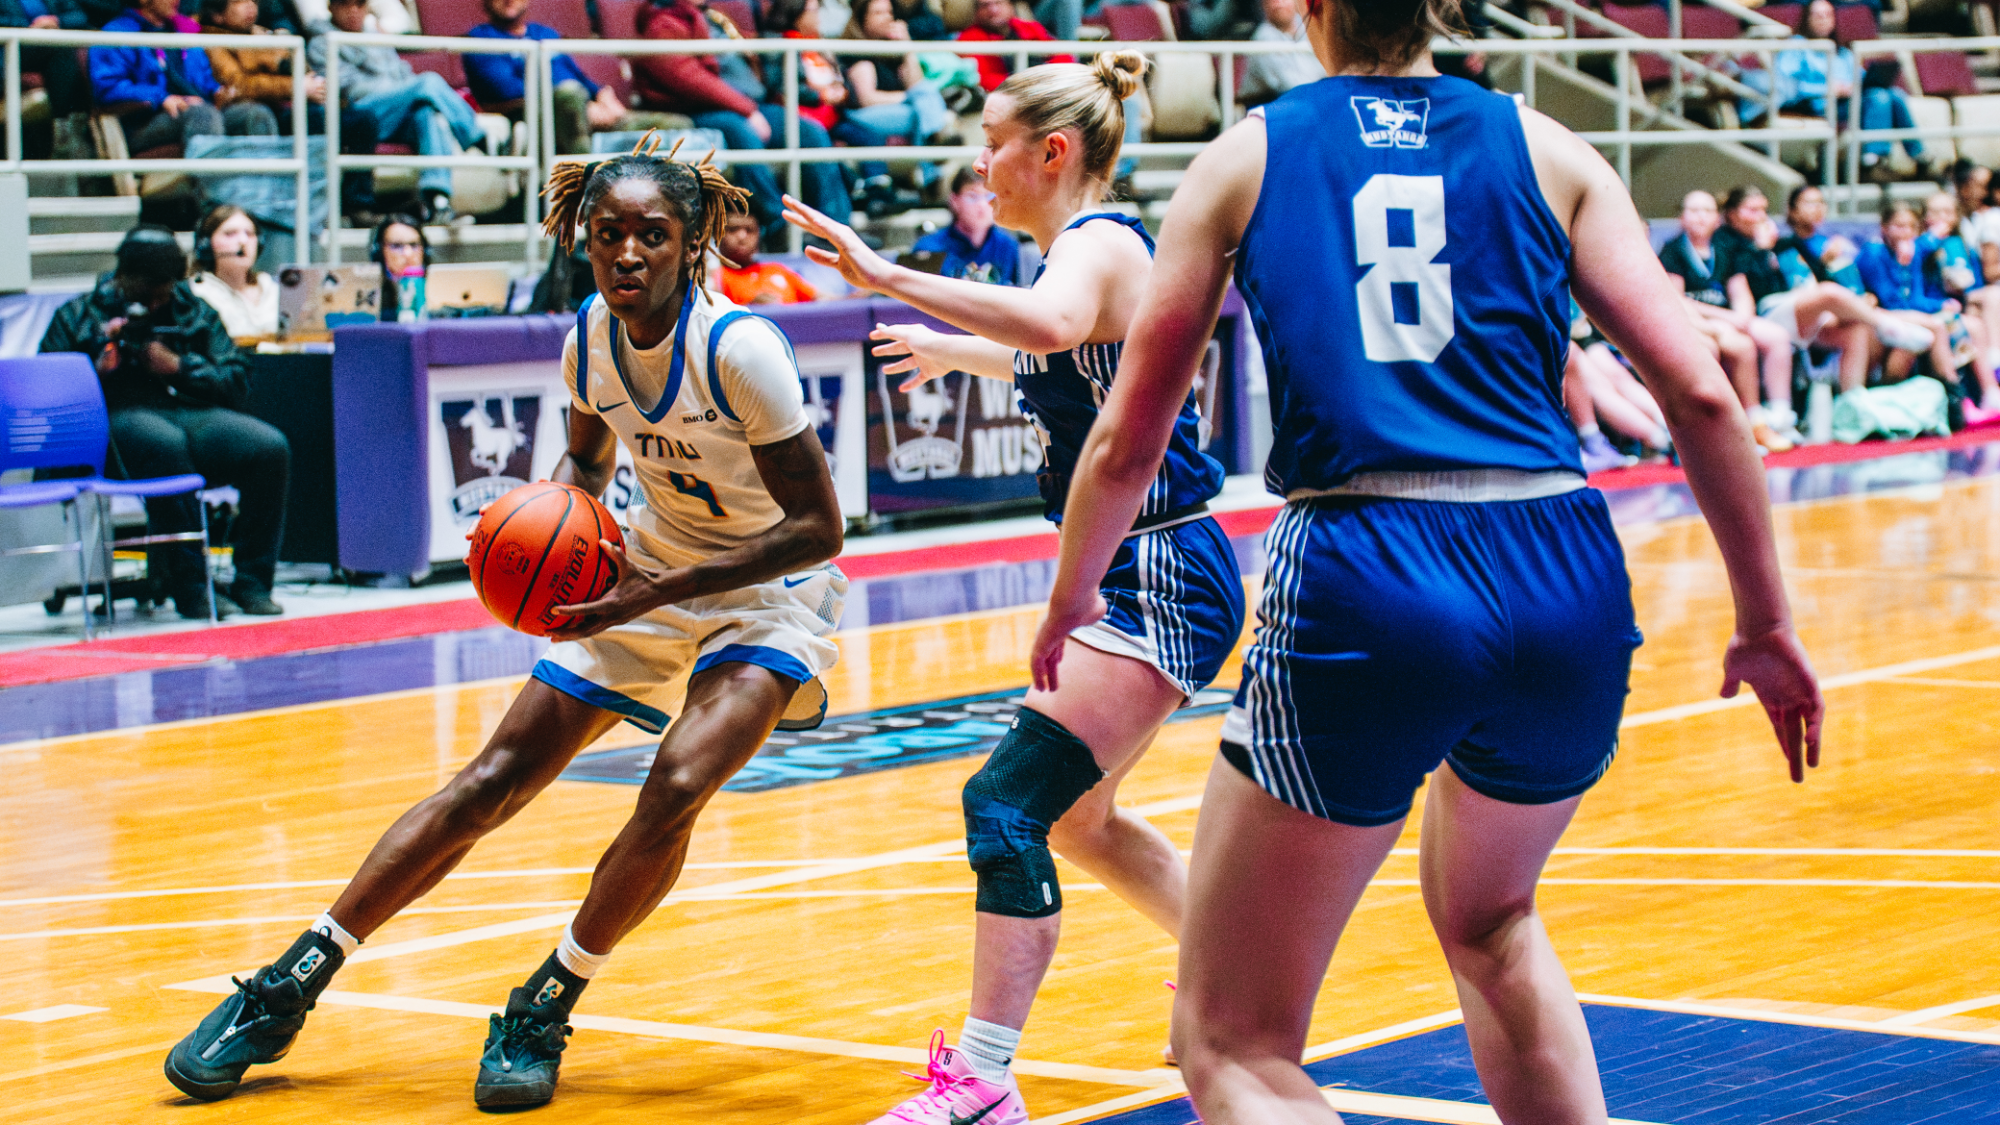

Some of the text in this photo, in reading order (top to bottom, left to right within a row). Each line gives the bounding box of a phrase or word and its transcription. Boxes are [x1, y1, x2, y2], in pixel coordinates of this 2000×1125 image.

[1352, 173, 1455, 364] 8
[682, 414, 704, 424] BMO
[634, 433, 703, 460] TMU
[667, 469, 728, 517] 4
